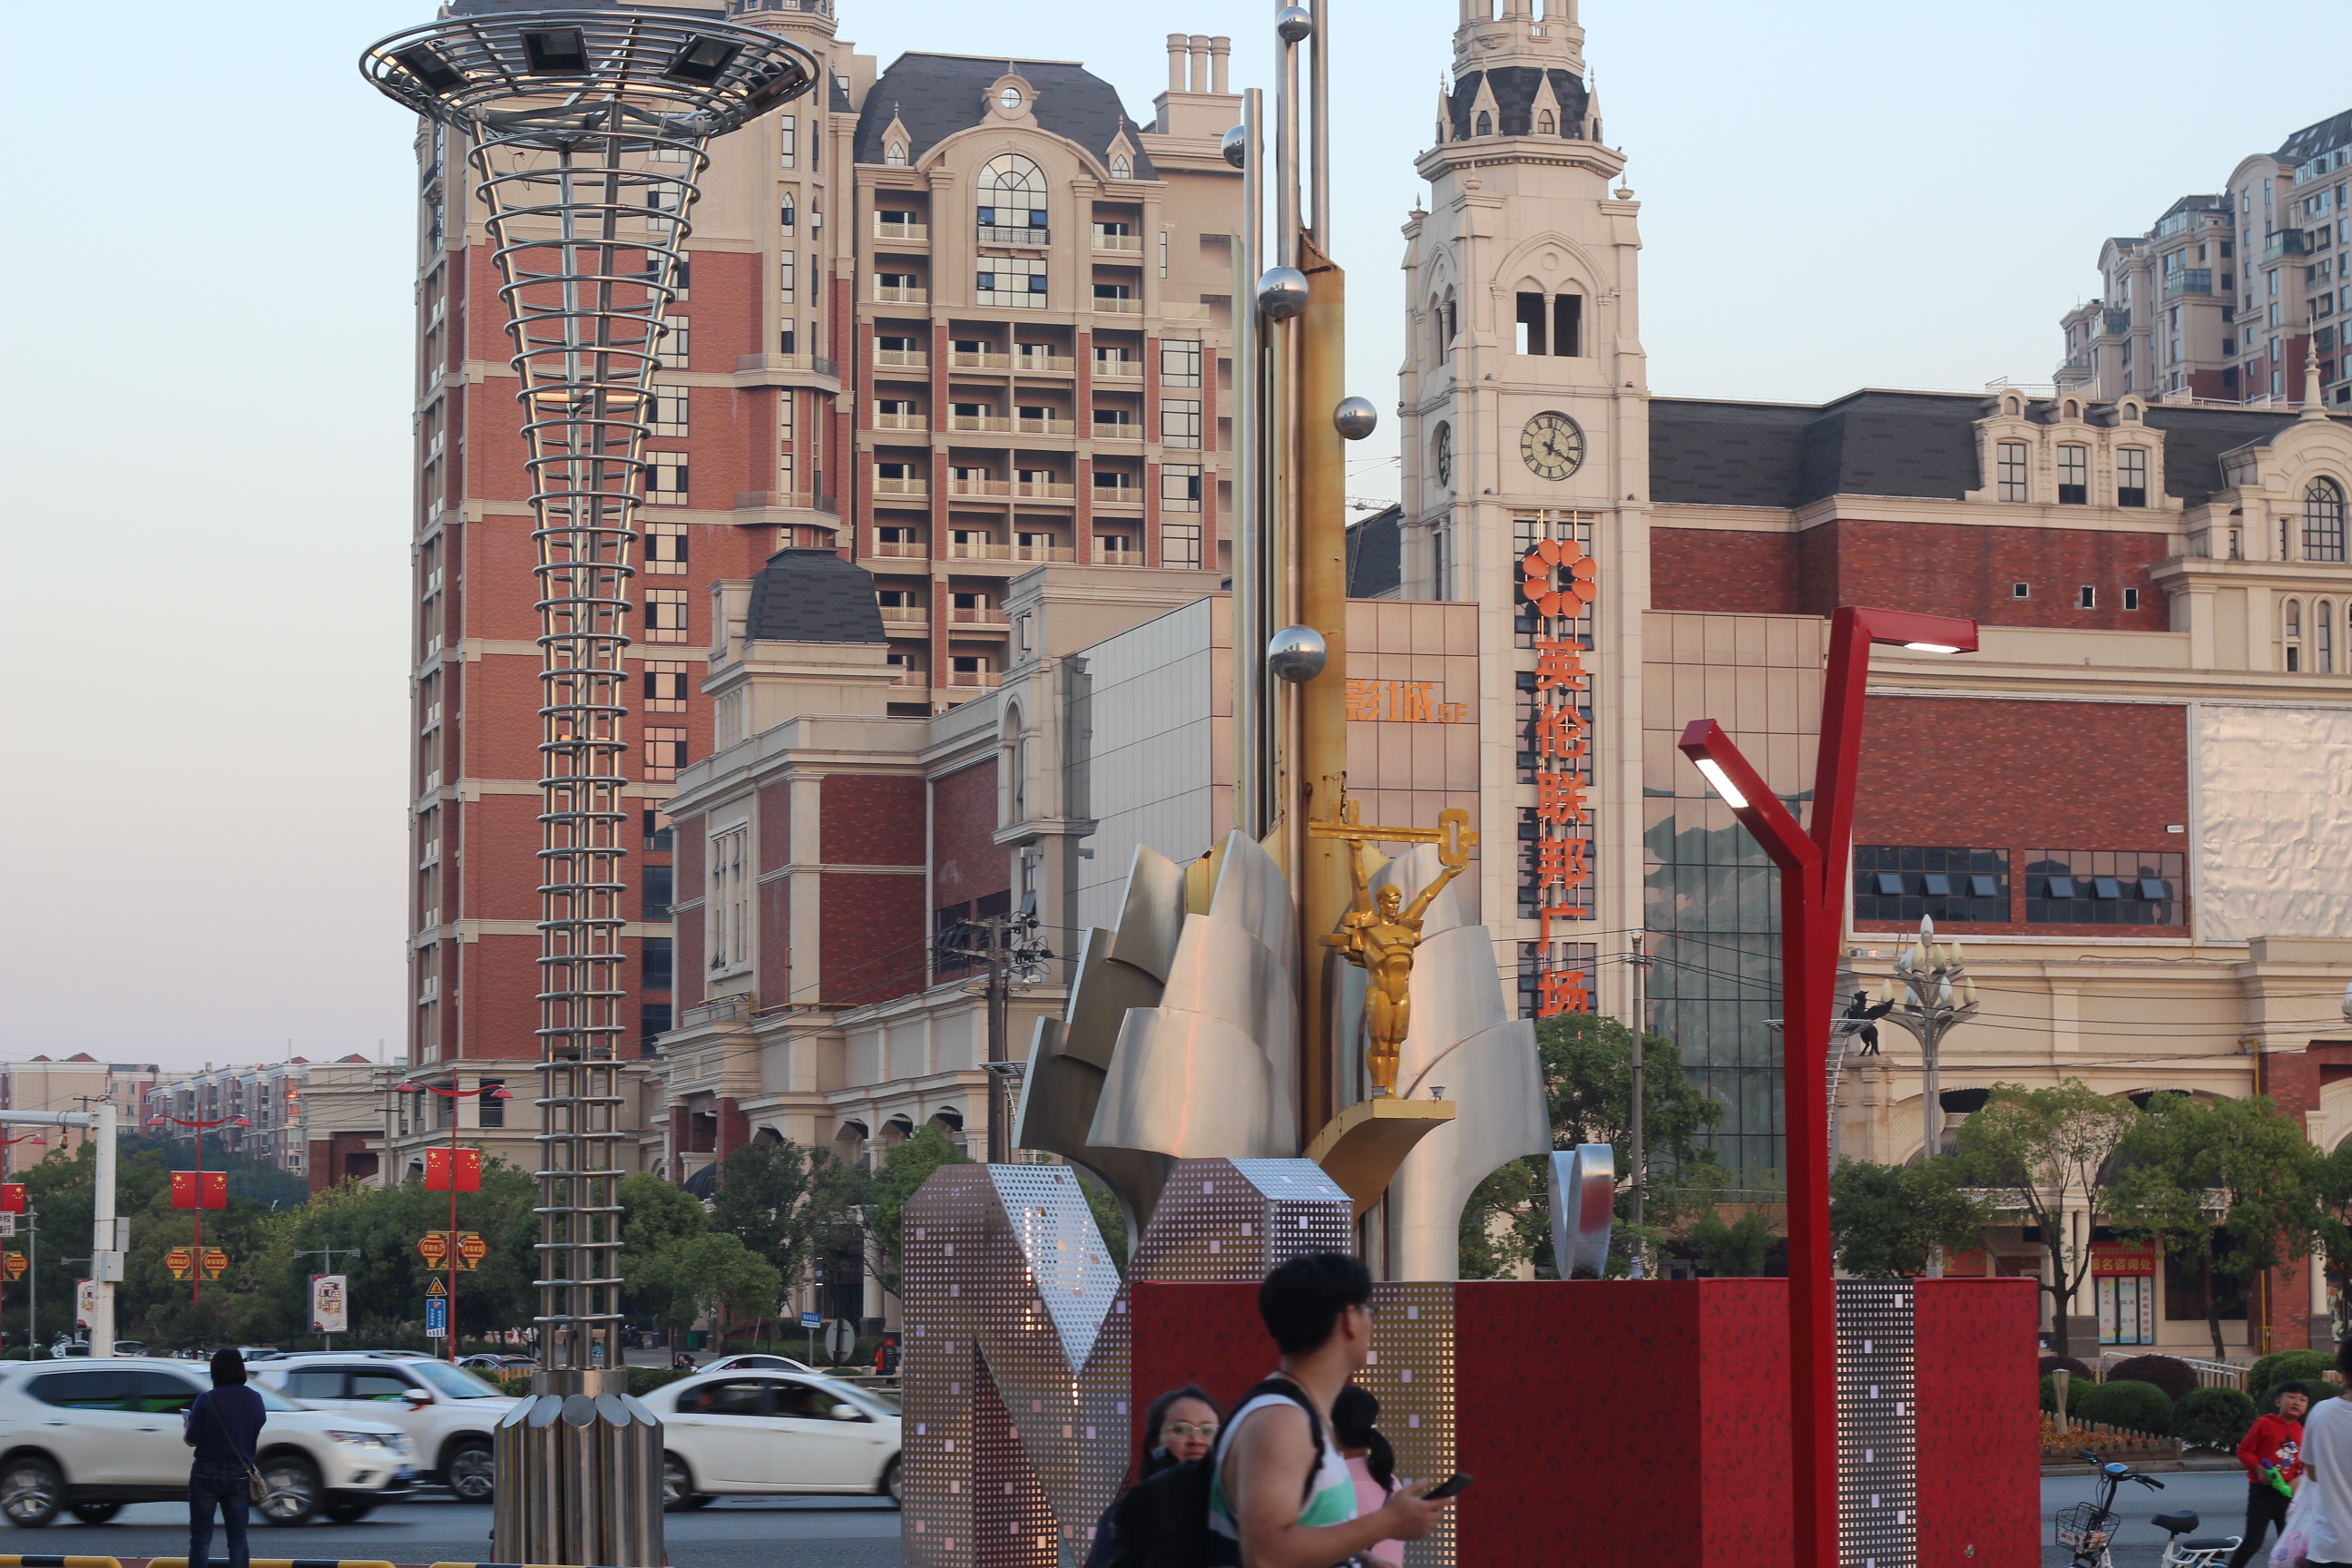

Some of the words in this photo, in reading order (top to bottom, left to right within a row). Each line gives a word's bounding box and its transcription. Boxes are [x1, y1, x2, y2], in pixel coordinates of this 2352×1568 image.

[1346, 680, 1435, 723] 影城
[1438, 703, 1469, 724] 5F
[1534, 637, 1589, 1018] 英伦联邦广场
[2092, 1258, 2151, 1270] 报名咨询处
